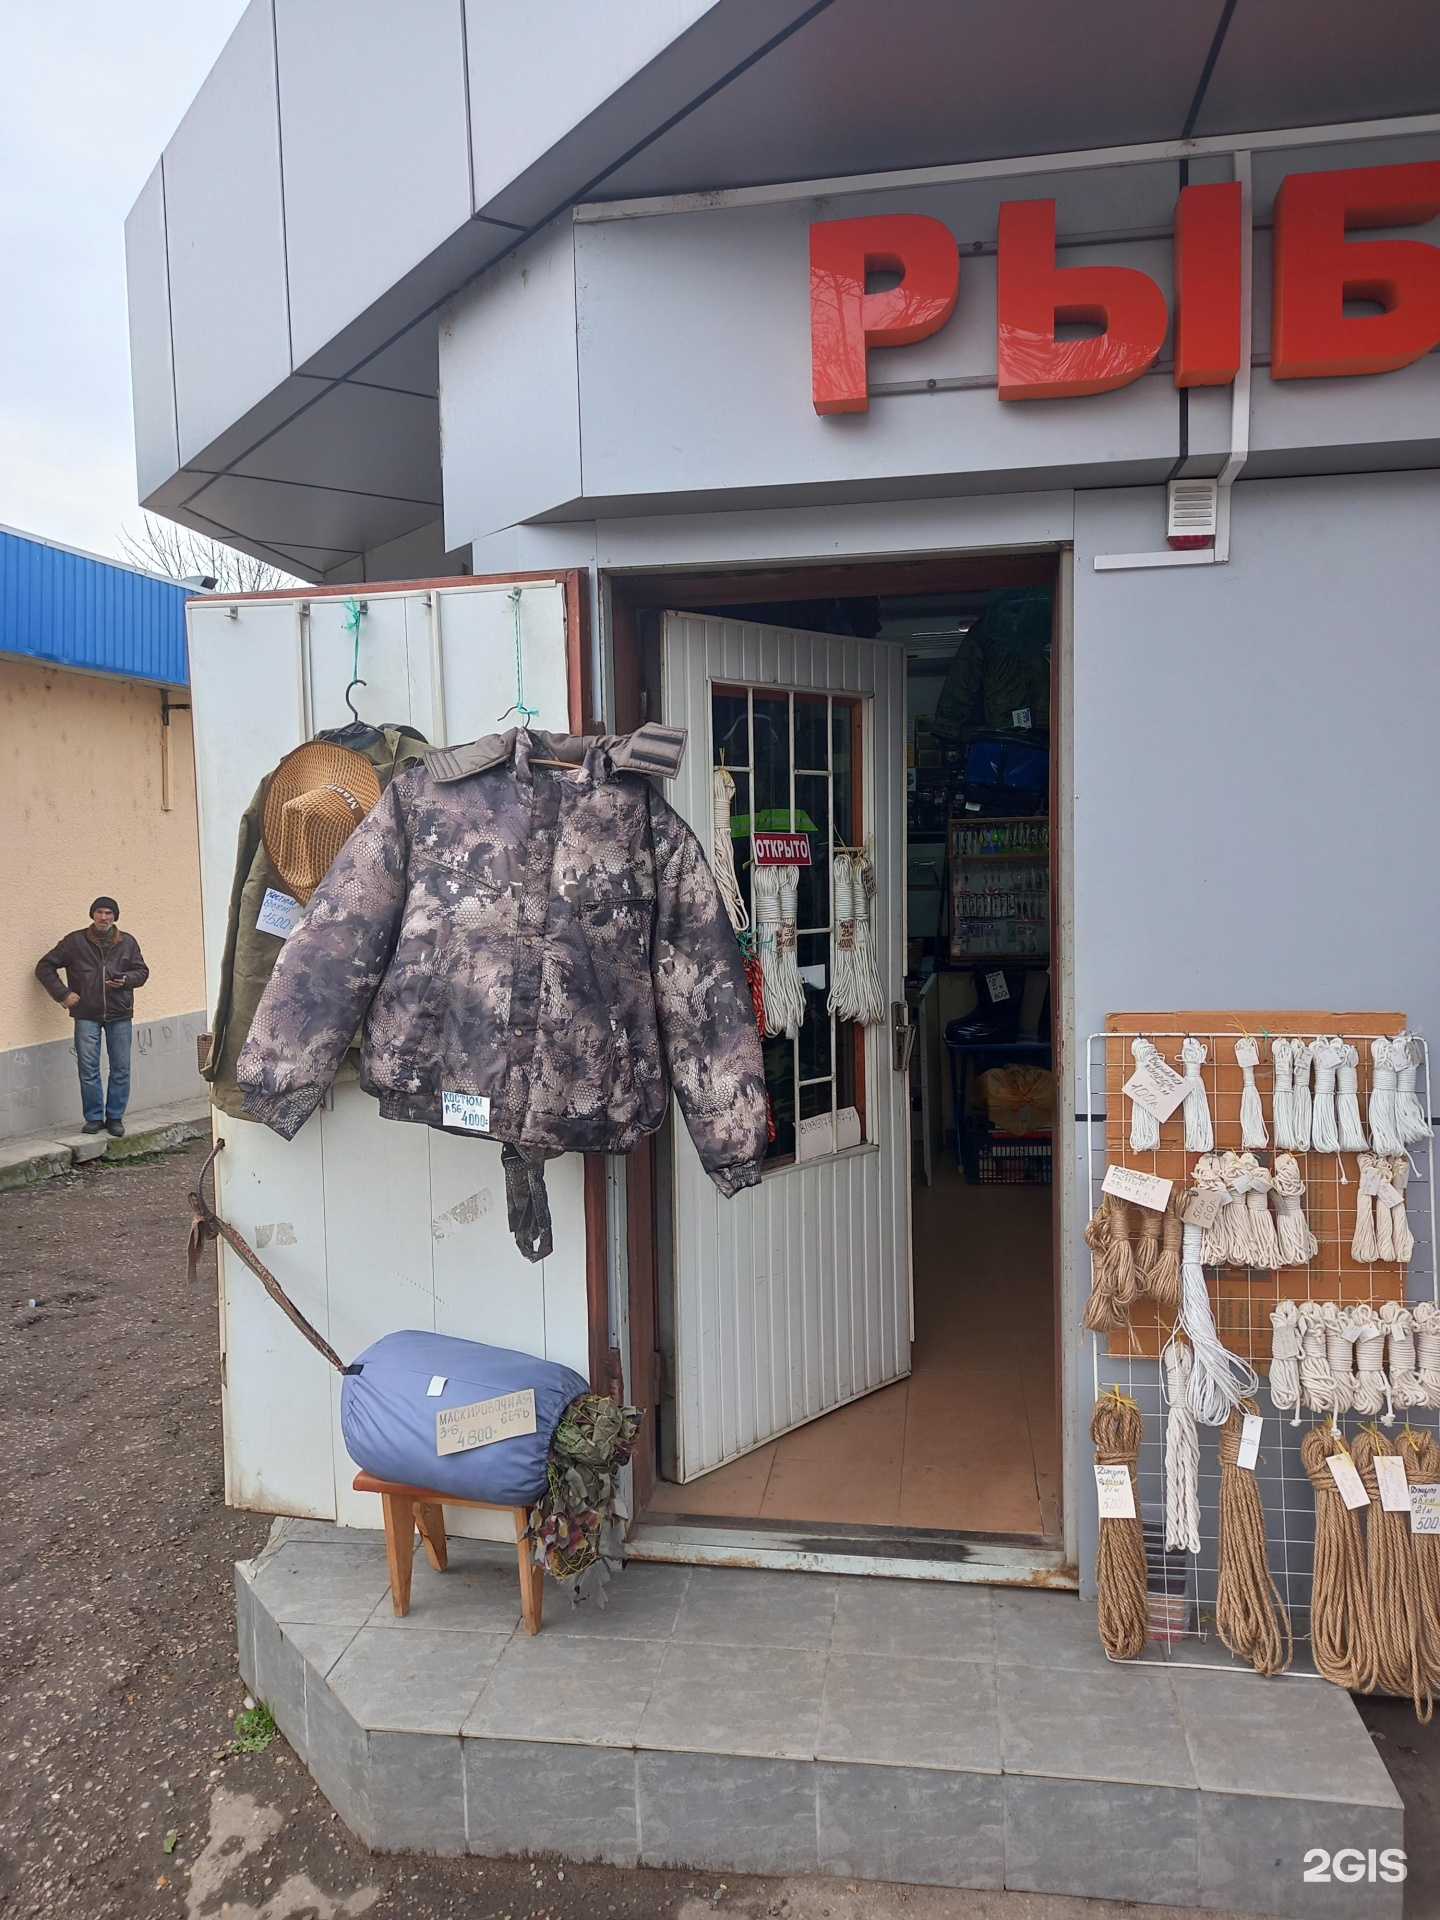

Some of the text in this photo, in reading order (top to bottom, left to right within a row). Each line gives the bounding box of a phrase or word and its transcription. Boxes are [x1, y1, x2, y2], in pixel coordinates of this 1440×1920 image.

[809, 161, 1440, 414] РЫБ
[756, 839, 807, 858] ОТКРЫТО
[444, 1092, 483, 1107] КОСТЮМ
